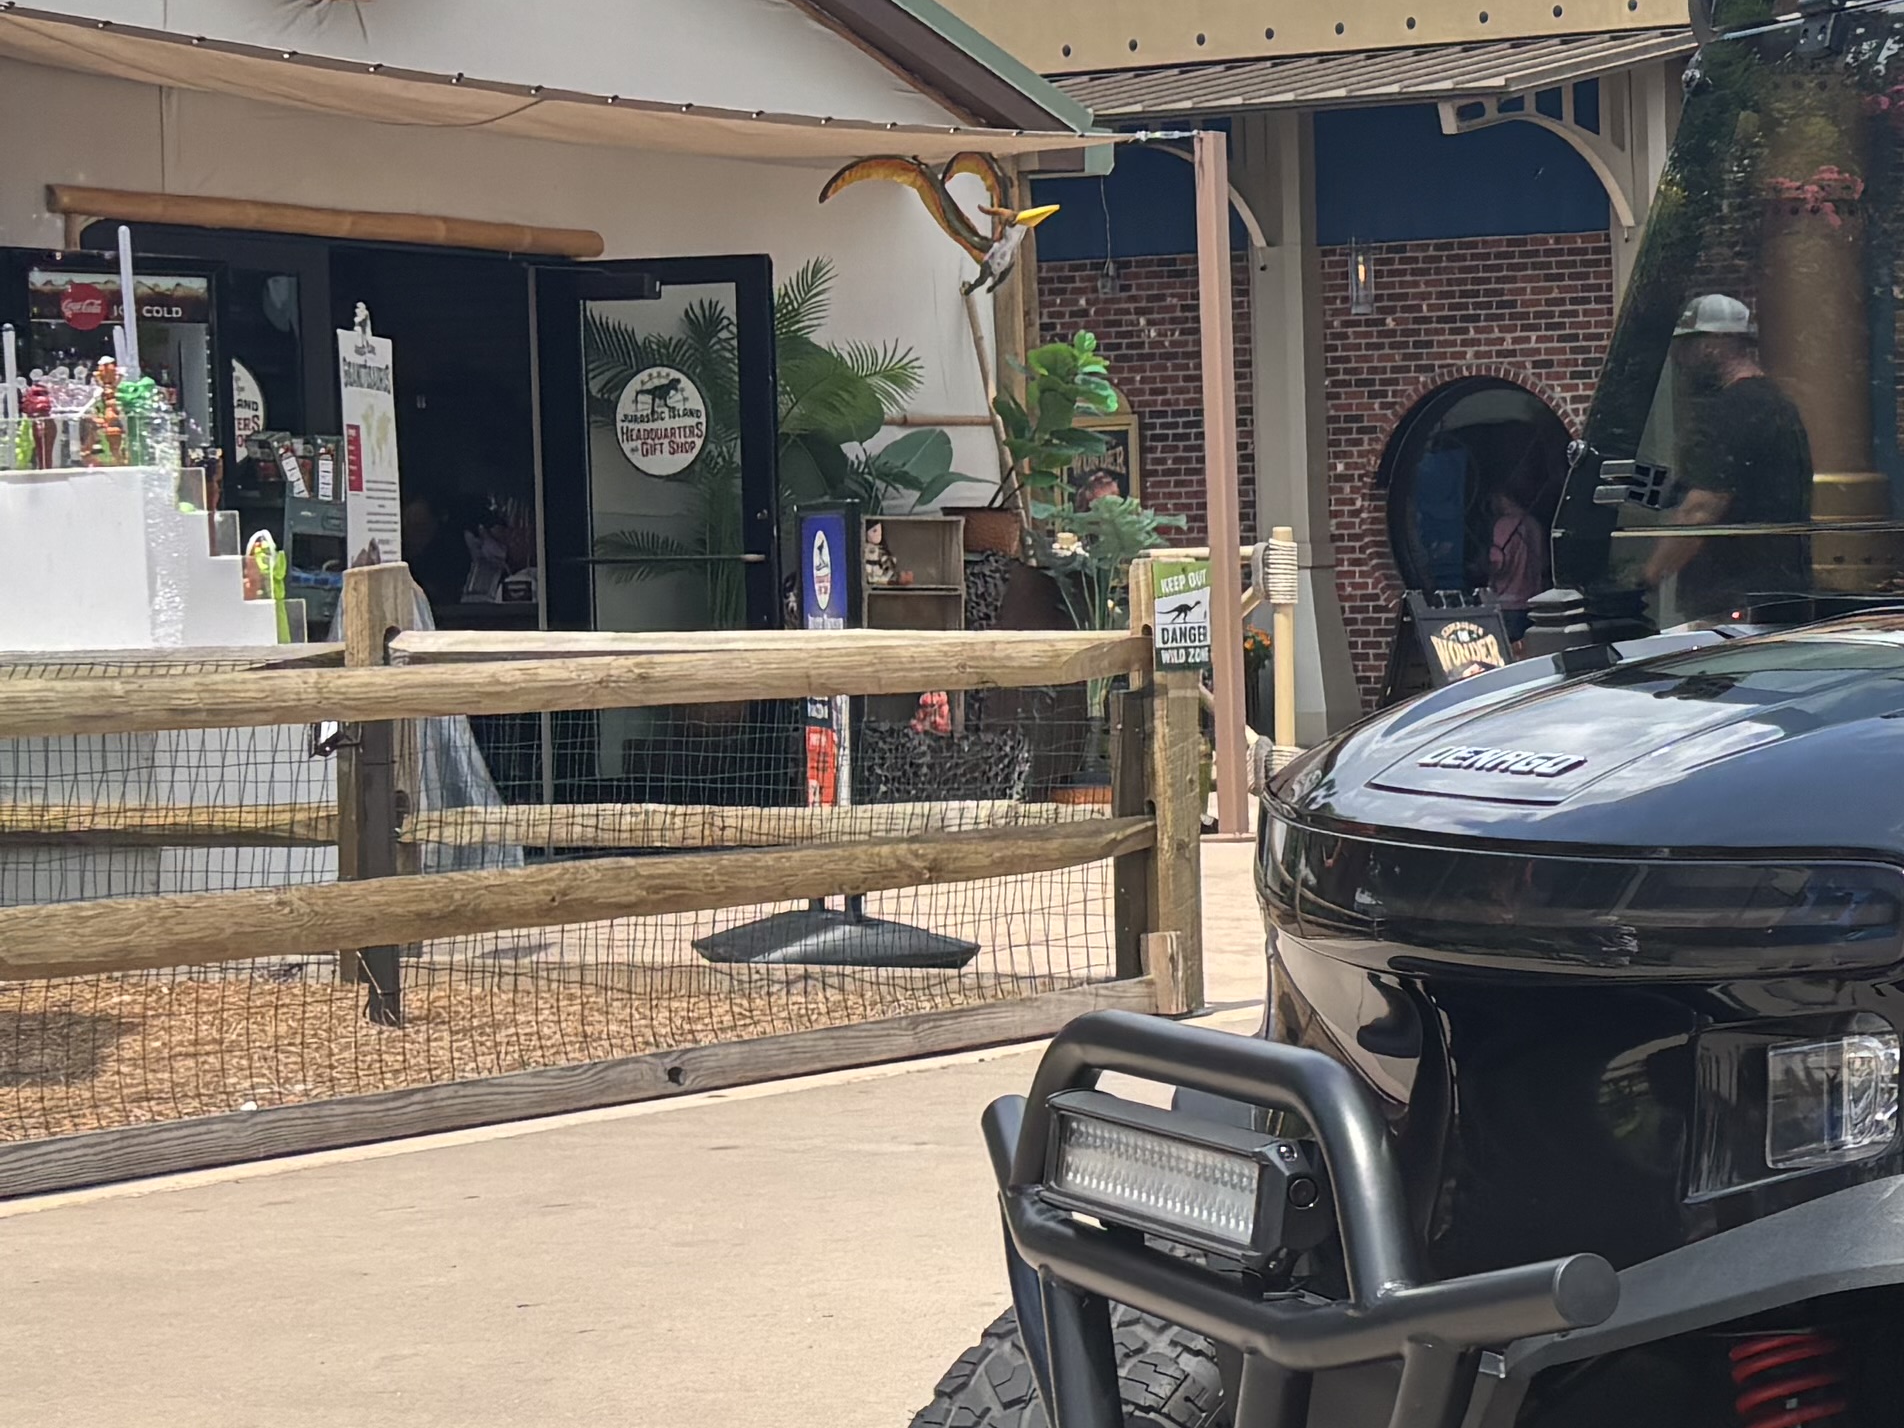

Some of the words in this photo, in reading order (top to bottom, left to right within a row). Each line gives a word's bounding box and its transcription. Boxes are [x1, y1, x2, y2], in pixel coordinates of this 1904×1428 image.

[142, 306, 182, 317] COLD
[668, 407, 702, 420] ISLAND
[620, 421, 704, 444] HEADQUARTERS
[640, 441, 665, 458] GIFT
[668, 439, 697, 456] SHOP
[1160, 574, 1187, 594] KEEP
[1187, 569, 1207, 587] OUT
[1160, 648, 1187, 664] WILD
[1430, 634, 1505, 674] WONDER
[1416, 746, 1588, 778] DENAGO
